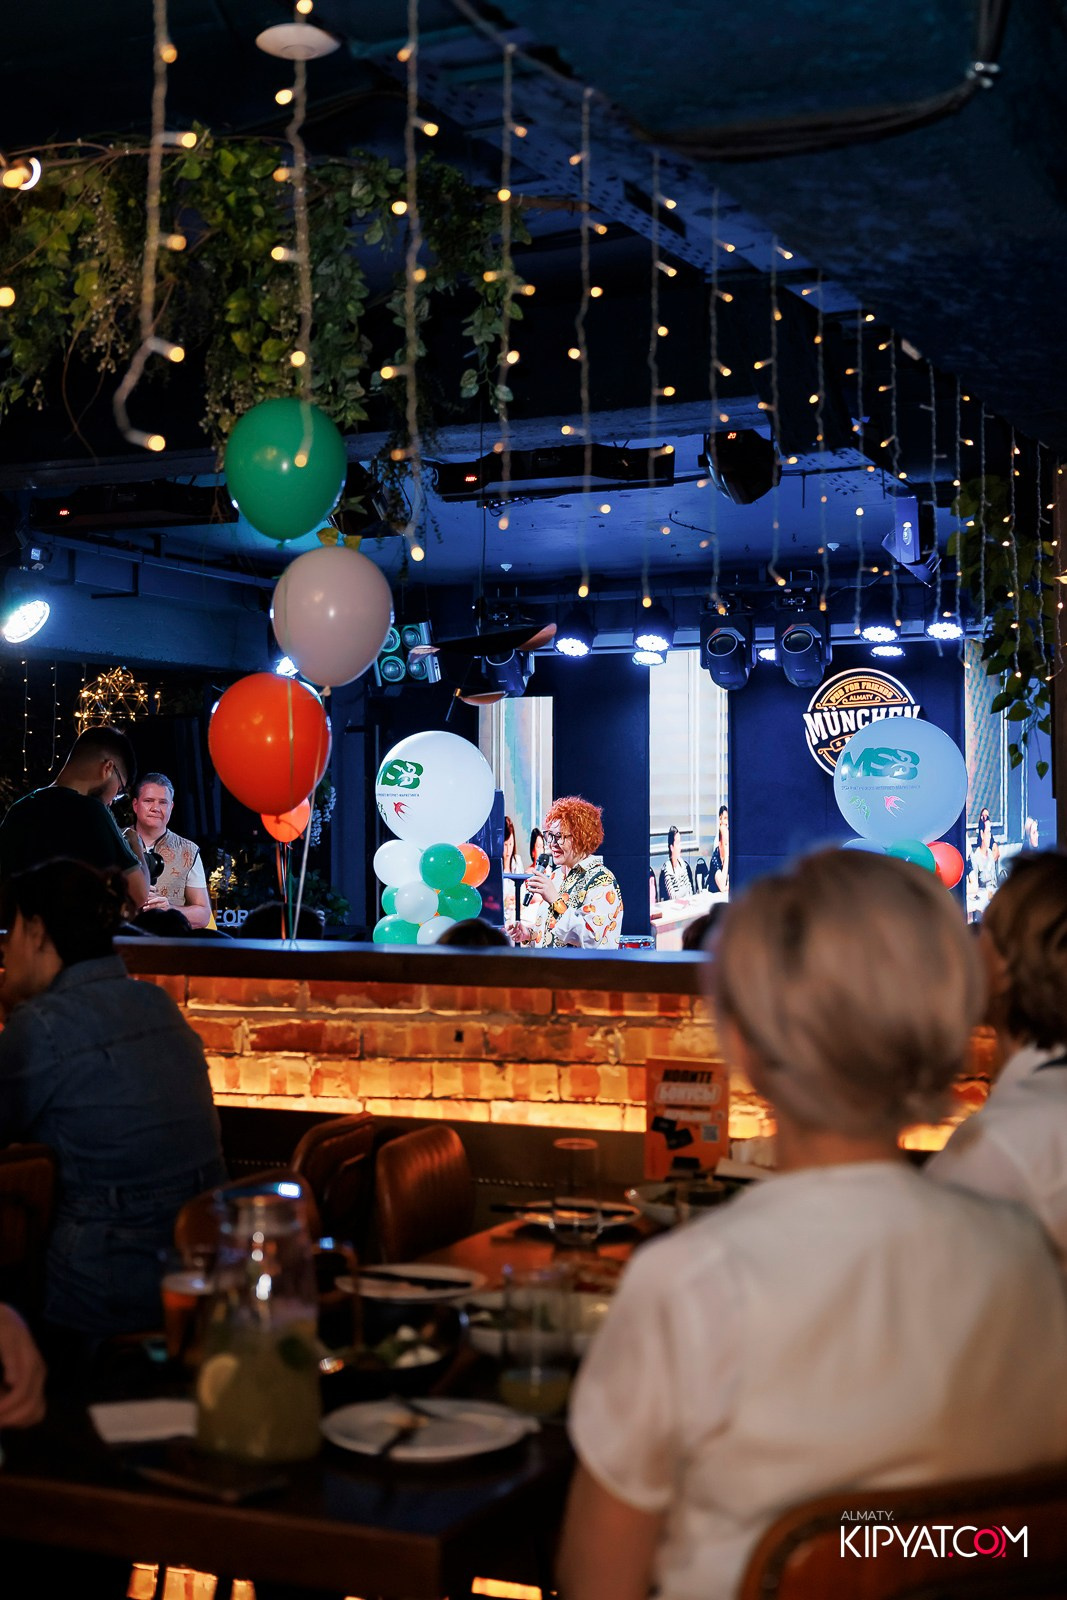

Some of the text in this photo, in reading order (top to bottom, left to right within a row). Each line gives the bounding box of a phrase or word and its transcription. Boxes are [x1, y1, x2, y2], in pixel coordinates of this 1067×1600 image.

[829, 681, 894, 703] PUB FOR FRIENDS
[849, 694, 874, 702] ALMATY
[841, 747, 920, 781] MSB
